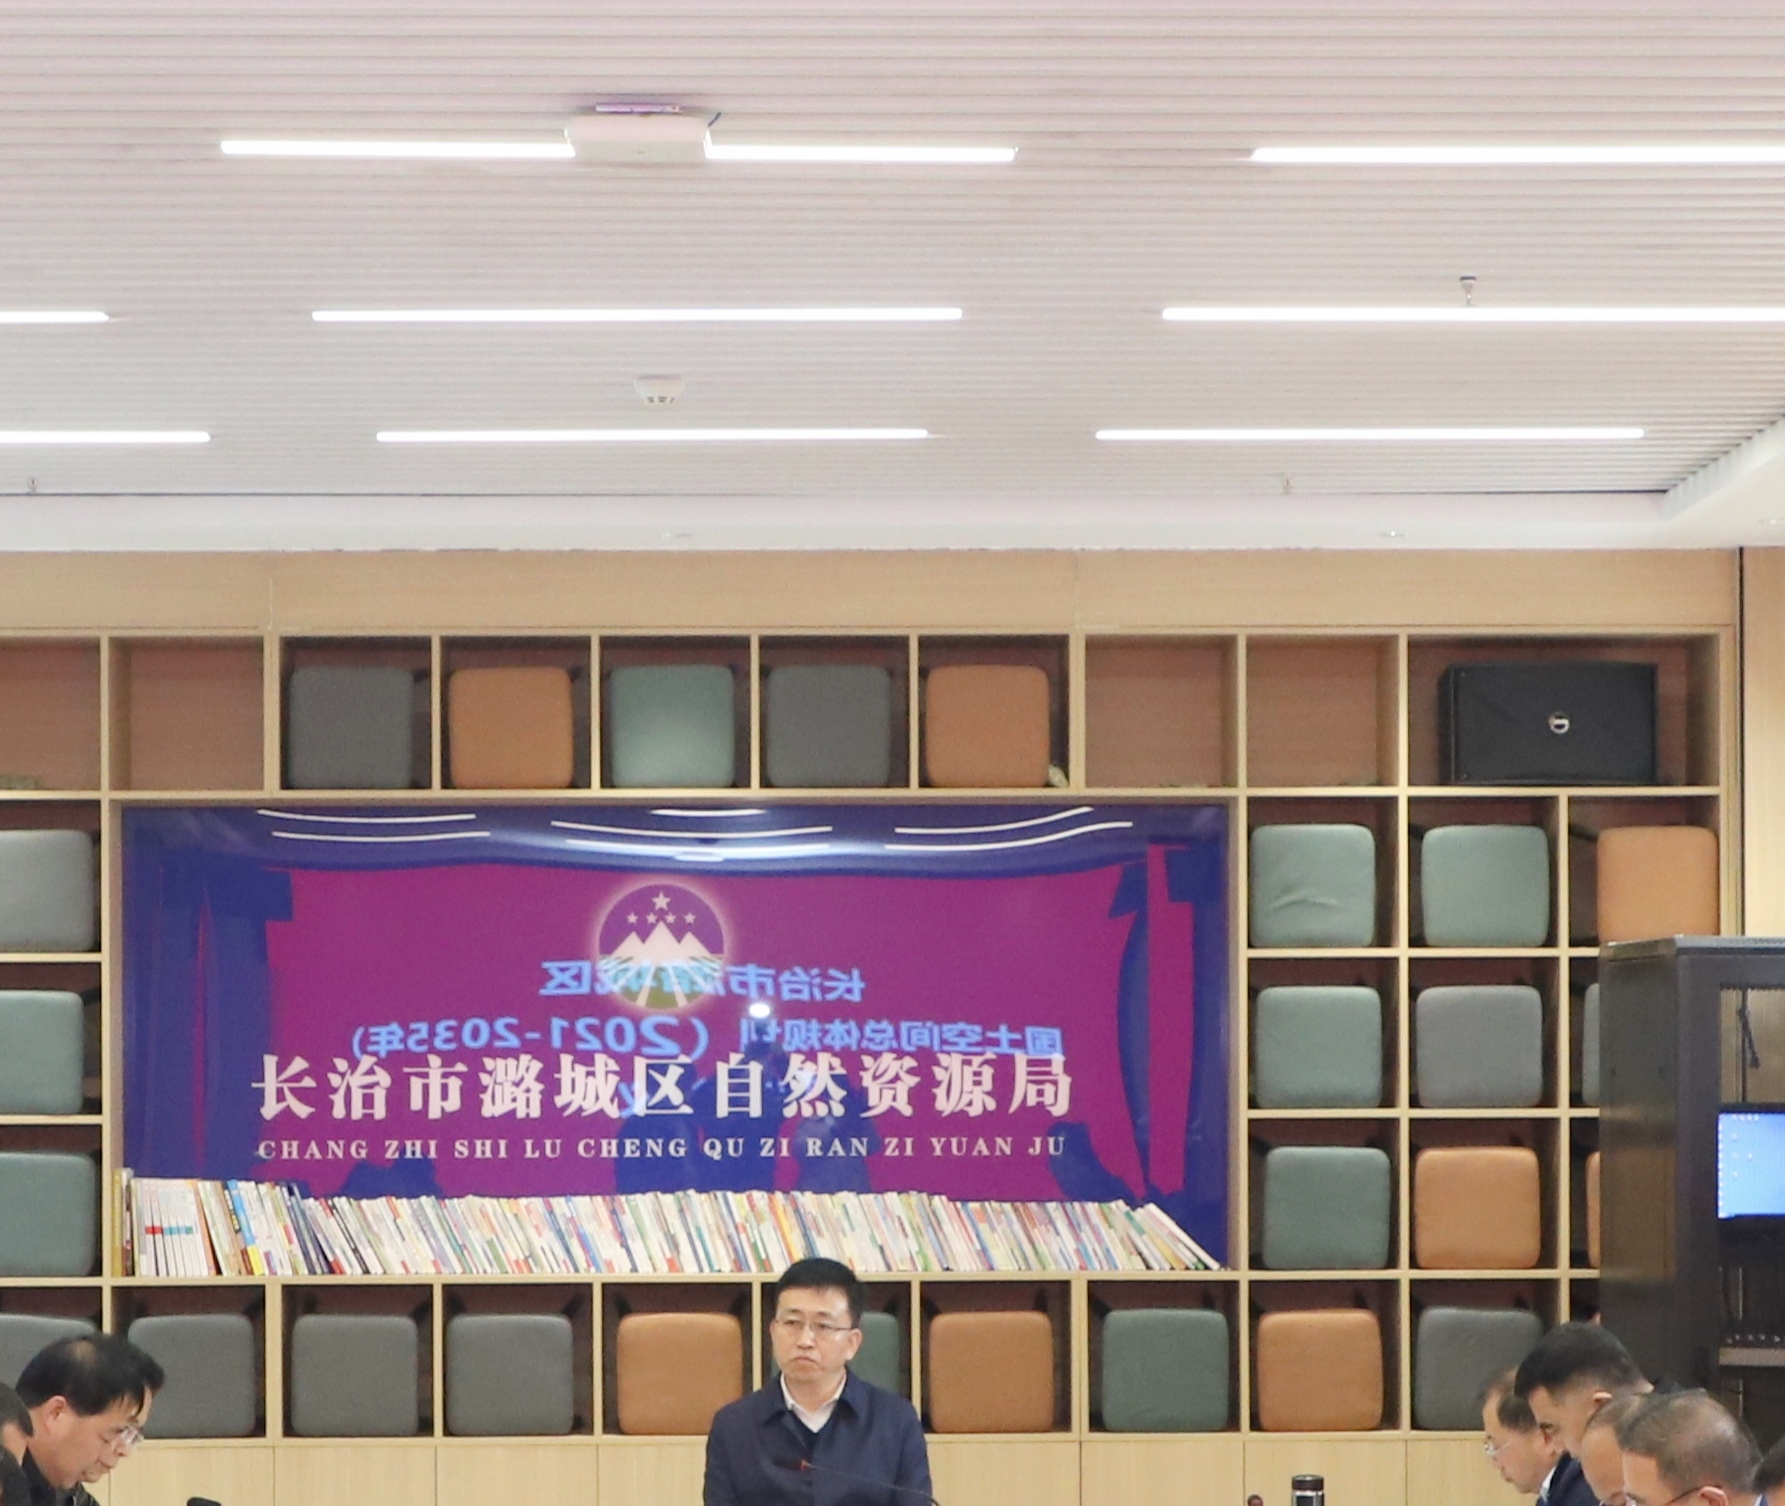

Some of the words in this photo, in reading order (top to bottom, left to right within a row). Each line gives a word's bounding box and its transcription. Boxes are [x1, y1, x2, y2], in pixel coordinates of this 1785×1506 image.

[251, 1052, 1073, 1121] 长治市潞城区自然资源局
[257, 1138, 369, 1160] CHANG
[384, 1138, 438, 1160] ZHI
[454, 1138, 507, 1160] SHI
[524, 1138, 562, 1160] LU
[577, 1138, 687, 1160] CHENG
[703, 1138, 744, 1164] QU
[760, 1138, 789, 1160] ZI
[806, 1138, 869, 1160] RAN
[885, 1138, 914, 1160] ZI
[931, 1138, 1013, 1160] YUAN
[1028, 1138, 1065, 1160] JU
